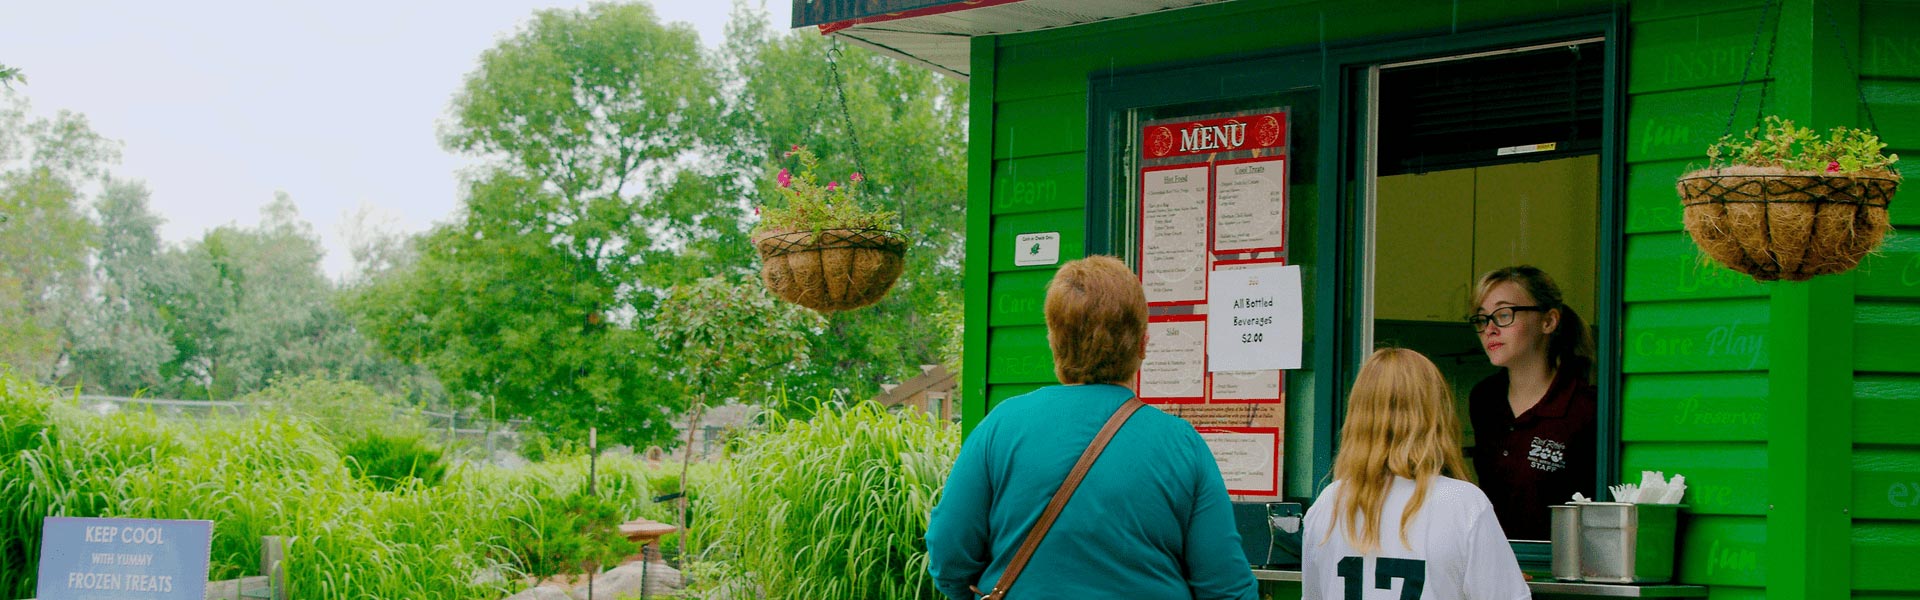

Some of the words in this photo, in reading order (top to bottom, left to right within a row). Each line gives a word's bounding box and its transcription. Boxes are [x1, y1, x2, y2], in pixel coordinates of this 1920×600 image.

[1180, 123, 1247, 152] MENU
[1641, 119, 1690, 154] fun
[999, 177, 1057, 208] Learn
[1677, 254, 1743, 292] Lear
[999, 294, 1037, 314] Care
[1233, 299, 1244, 309] All
[1246, 297, 1273, 309] Bottled
[1233, 316, 1272, 327] Beverages
[1635, 332, 1693, 356] Care
[1705, 320, 1764, 370] Play
[1675, 395, 1762, 425] Preserve
[1530, 461, 1557, 472] STAFF
[85, 526, 118, 543] KEEP
[121, 527, 164, 544] COOL
[92, 553, 114, 565] WITH
[117, 554, 153, 566] YUMMY
[68, 572, 121, 590] FROZEN
[125, 574, 172, 592] TREATS
[1337, 556, 1426, 600] 17
